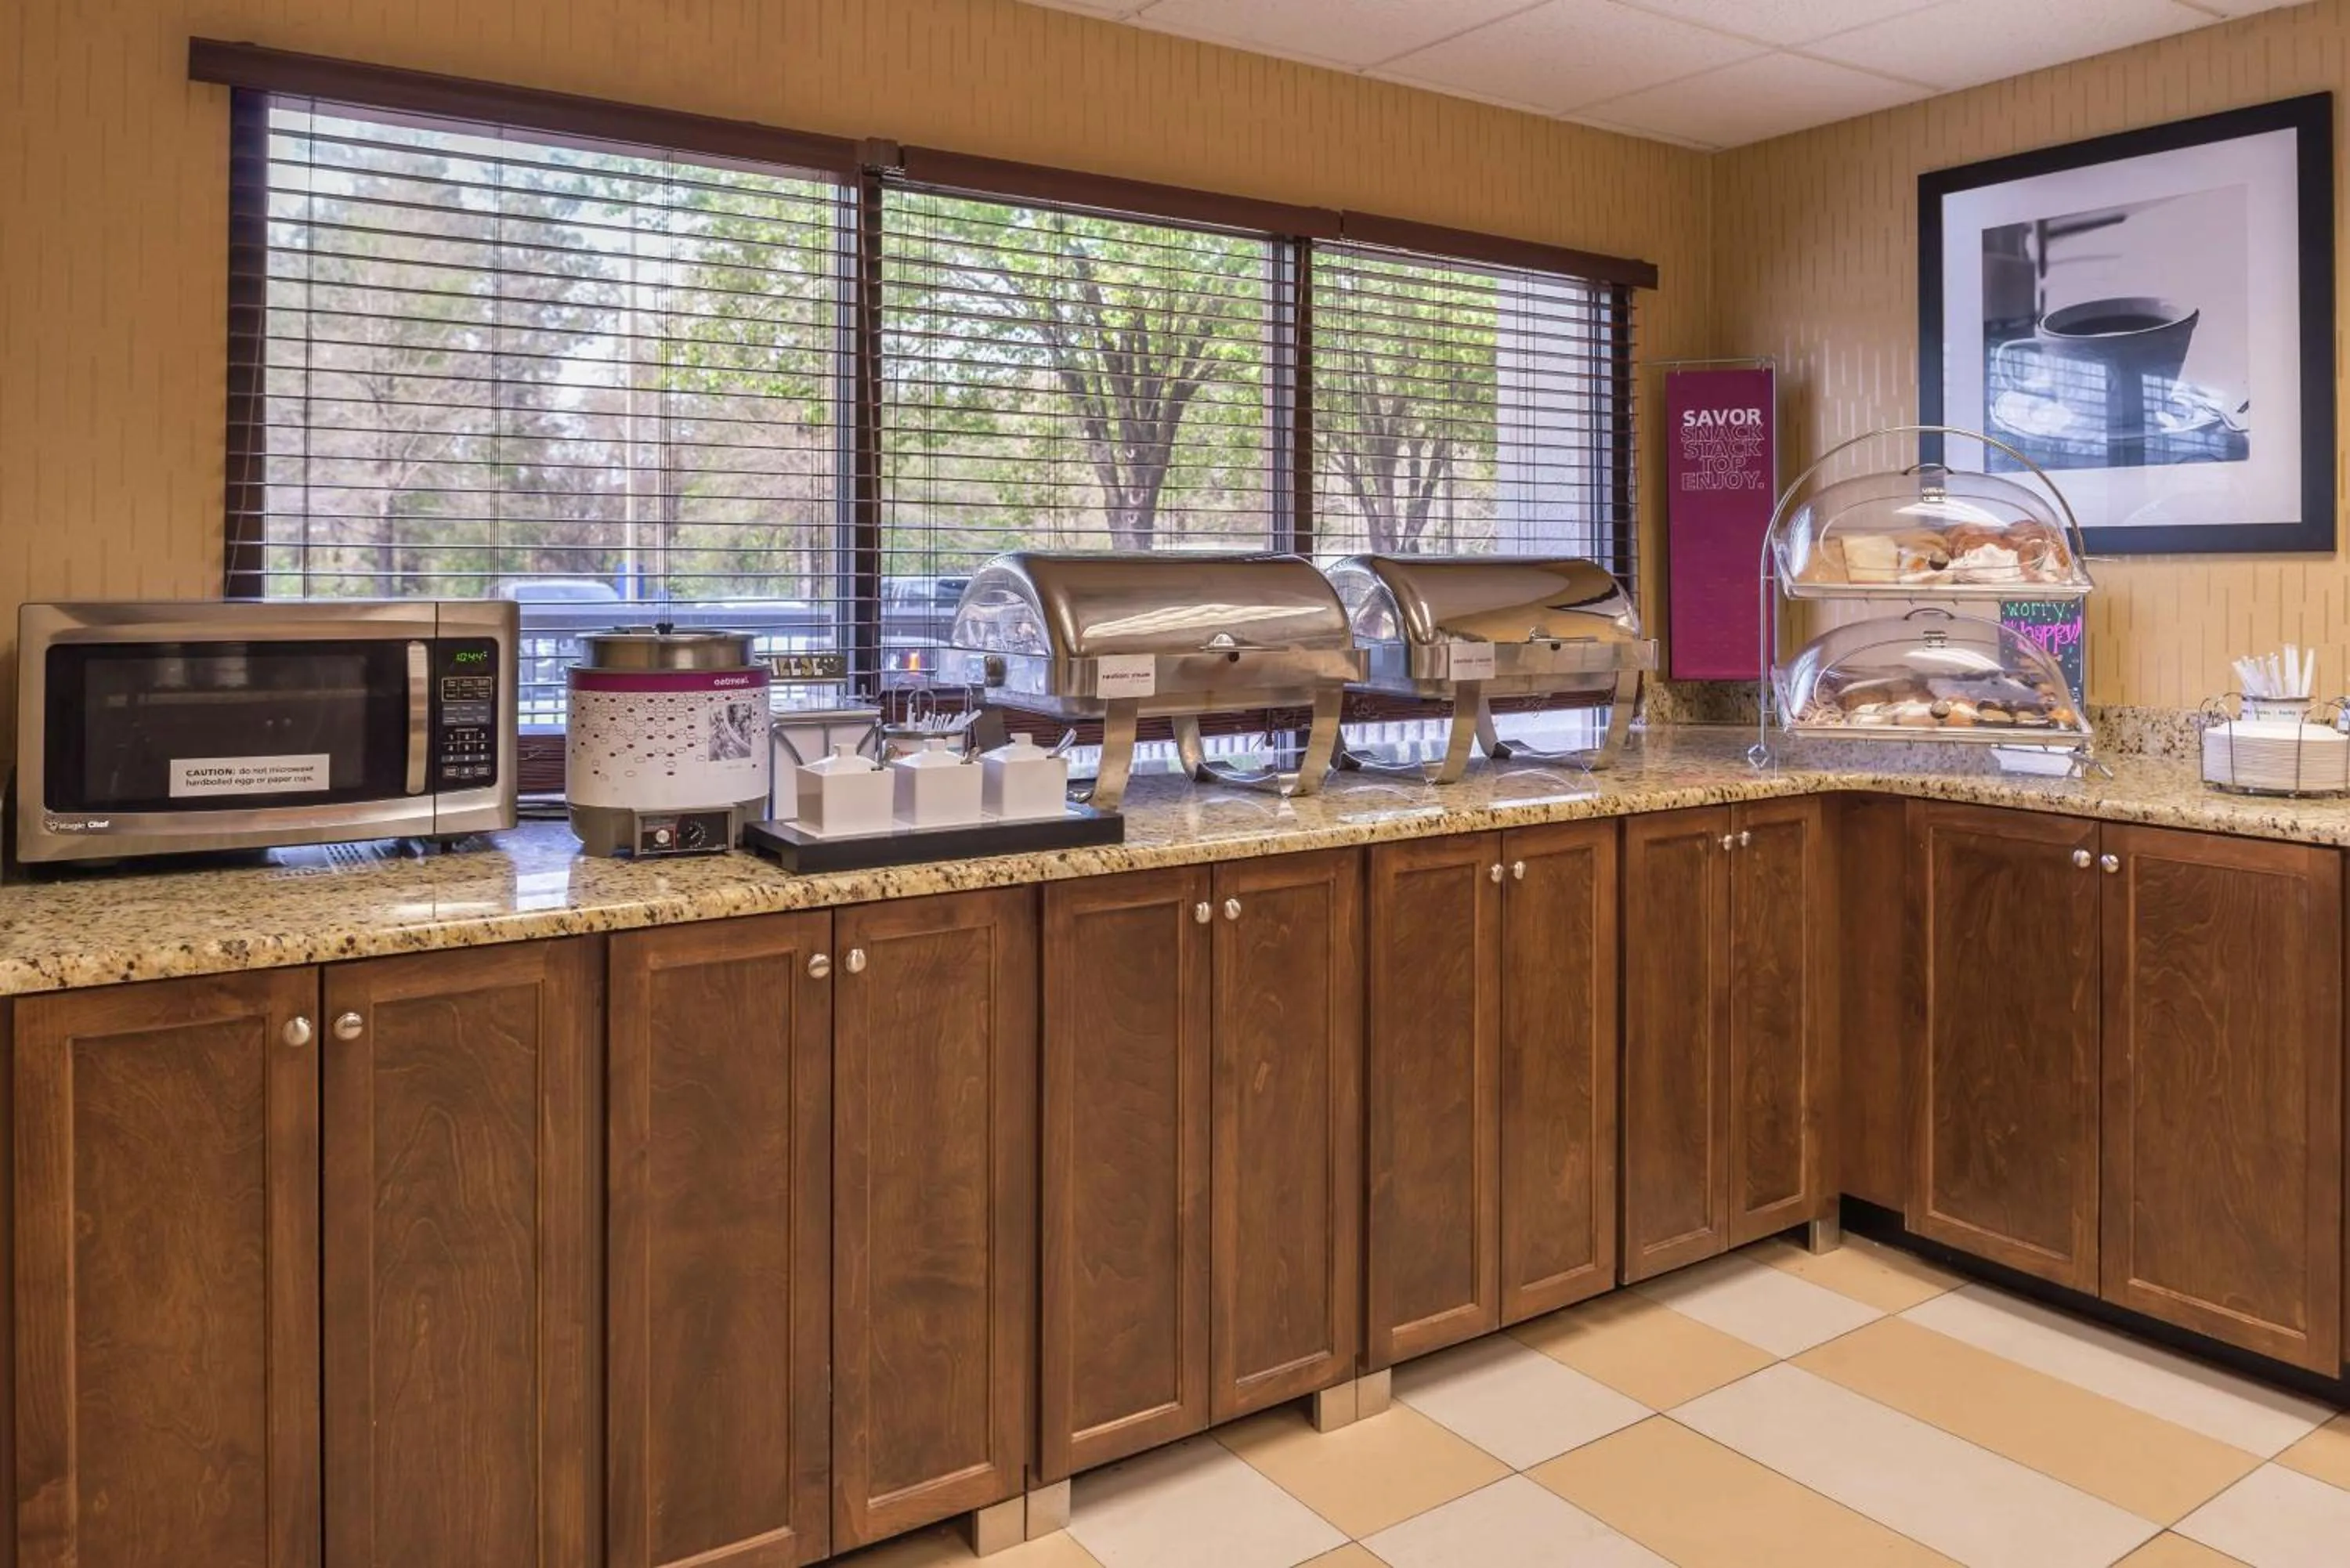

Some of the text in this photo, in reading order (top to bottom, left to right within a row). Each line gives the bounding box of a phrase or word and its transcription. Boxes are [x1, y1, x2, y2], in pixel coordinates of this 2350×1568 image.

[1683, 408, 1762, 427] SAVOR
[1680, 424, 1765, 442] SNACK
[1683, 439, 1762, 459] STACK
[1699, 456, 1746, 473] TOP
[1682, 471, 1765, 490] ENJOY.
